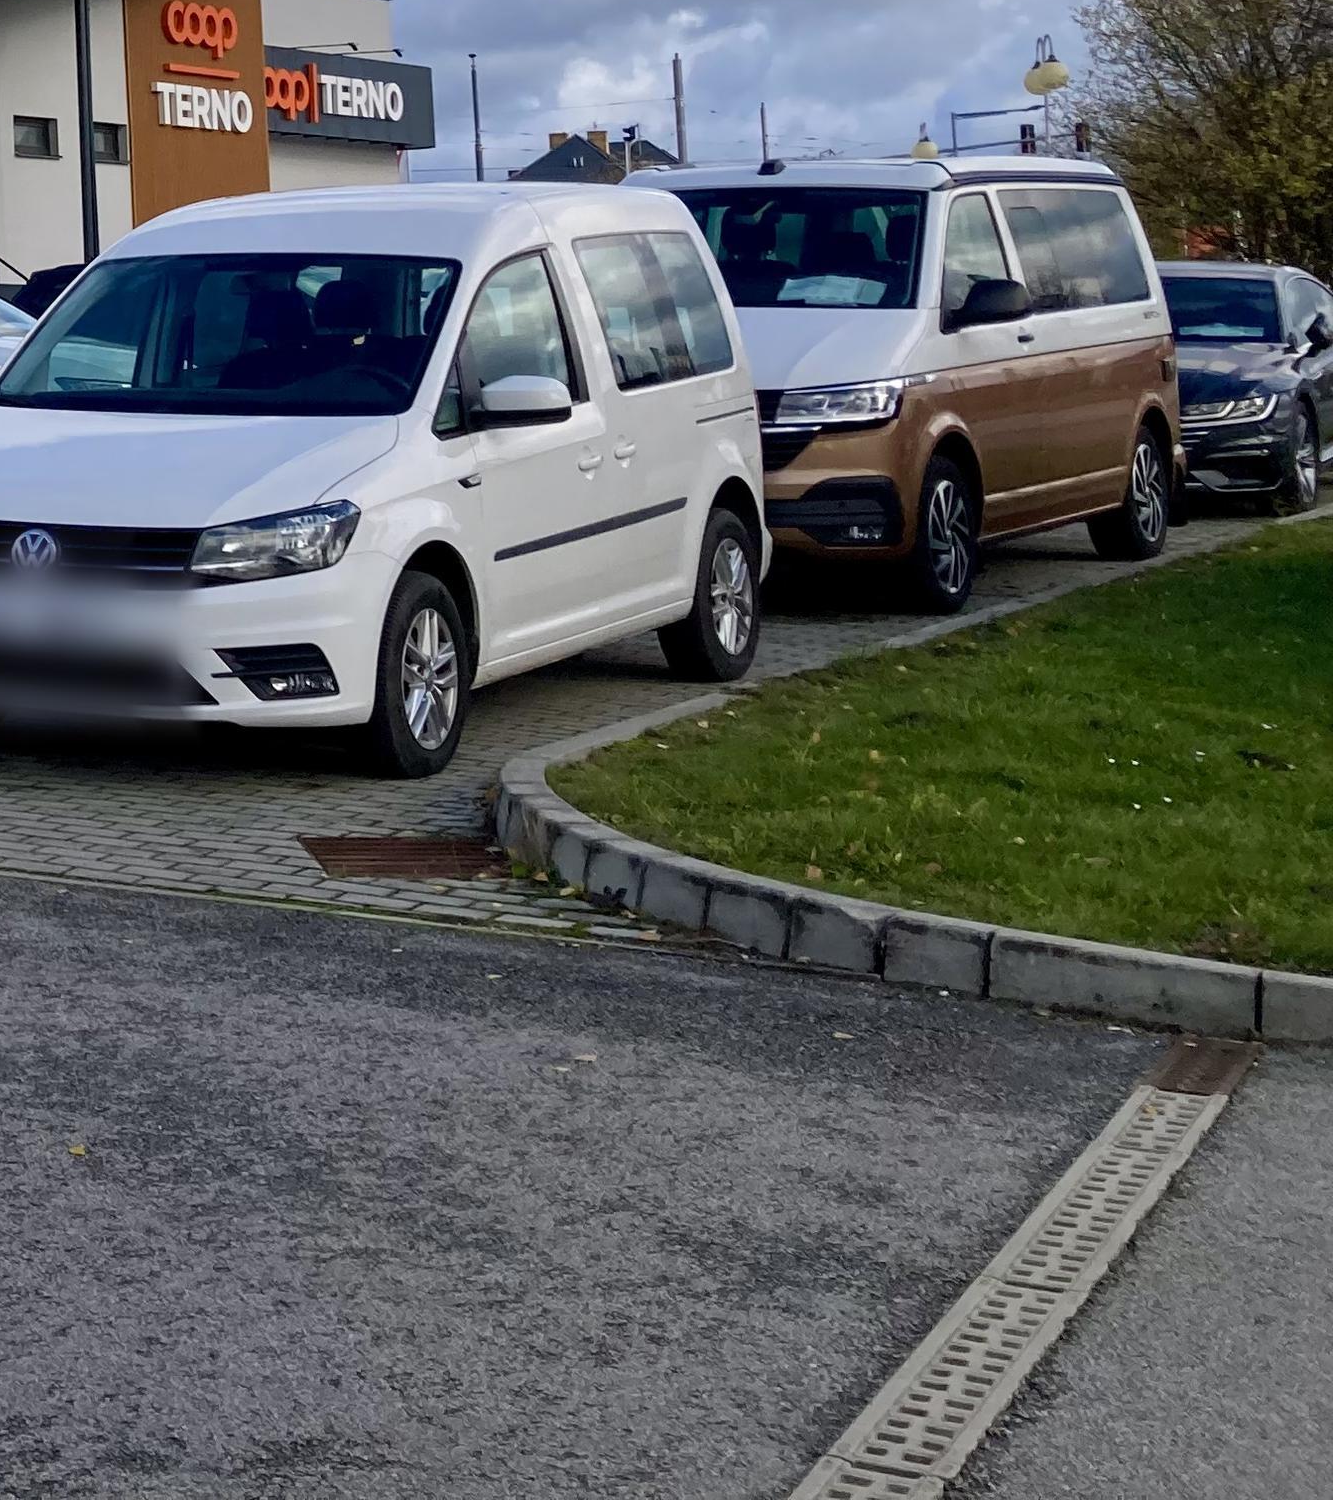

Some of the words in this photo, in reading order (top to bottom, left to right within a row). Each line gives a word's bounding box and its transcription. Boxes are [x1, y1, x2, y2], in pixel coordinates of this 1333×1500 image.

[161, 0, 238, 60] coop
[150, 81, 253, 133] TERNO
[264, 66, 310, 121] oop
[317, 74, 404, 122] TERNO
